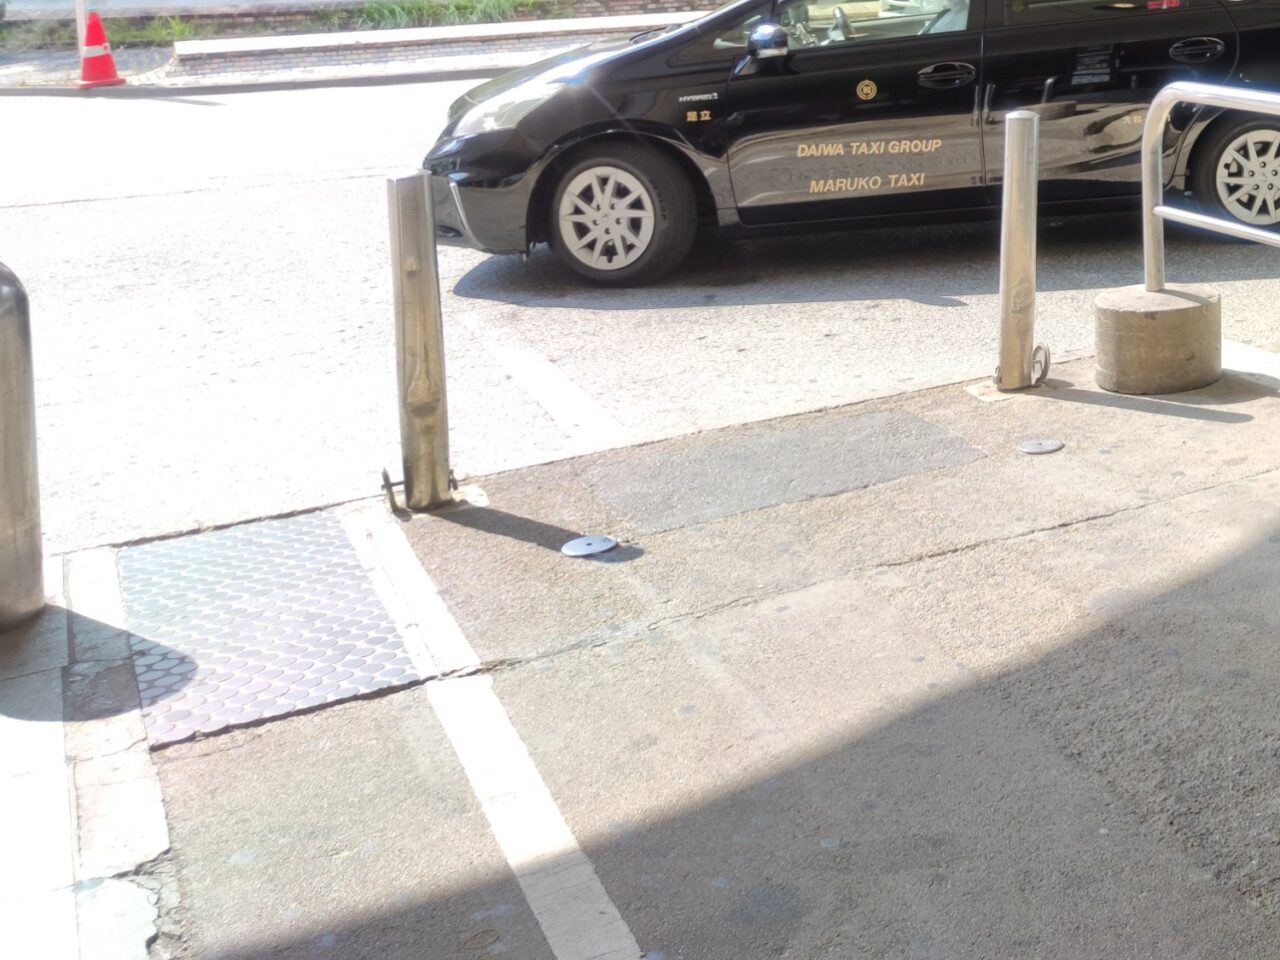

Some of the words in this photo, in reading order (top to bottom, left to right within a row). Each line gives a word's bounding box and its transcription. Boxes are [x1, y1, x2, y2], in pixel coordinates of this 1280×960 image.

[796, 143, 845, 158] DAIWA
[850, 141, 885, 156] TAXI
[888, 139, 942, 153] GROUP
[809, 176, 881, 194] MARUKO
[889, 172, 925, 187] TAXI
